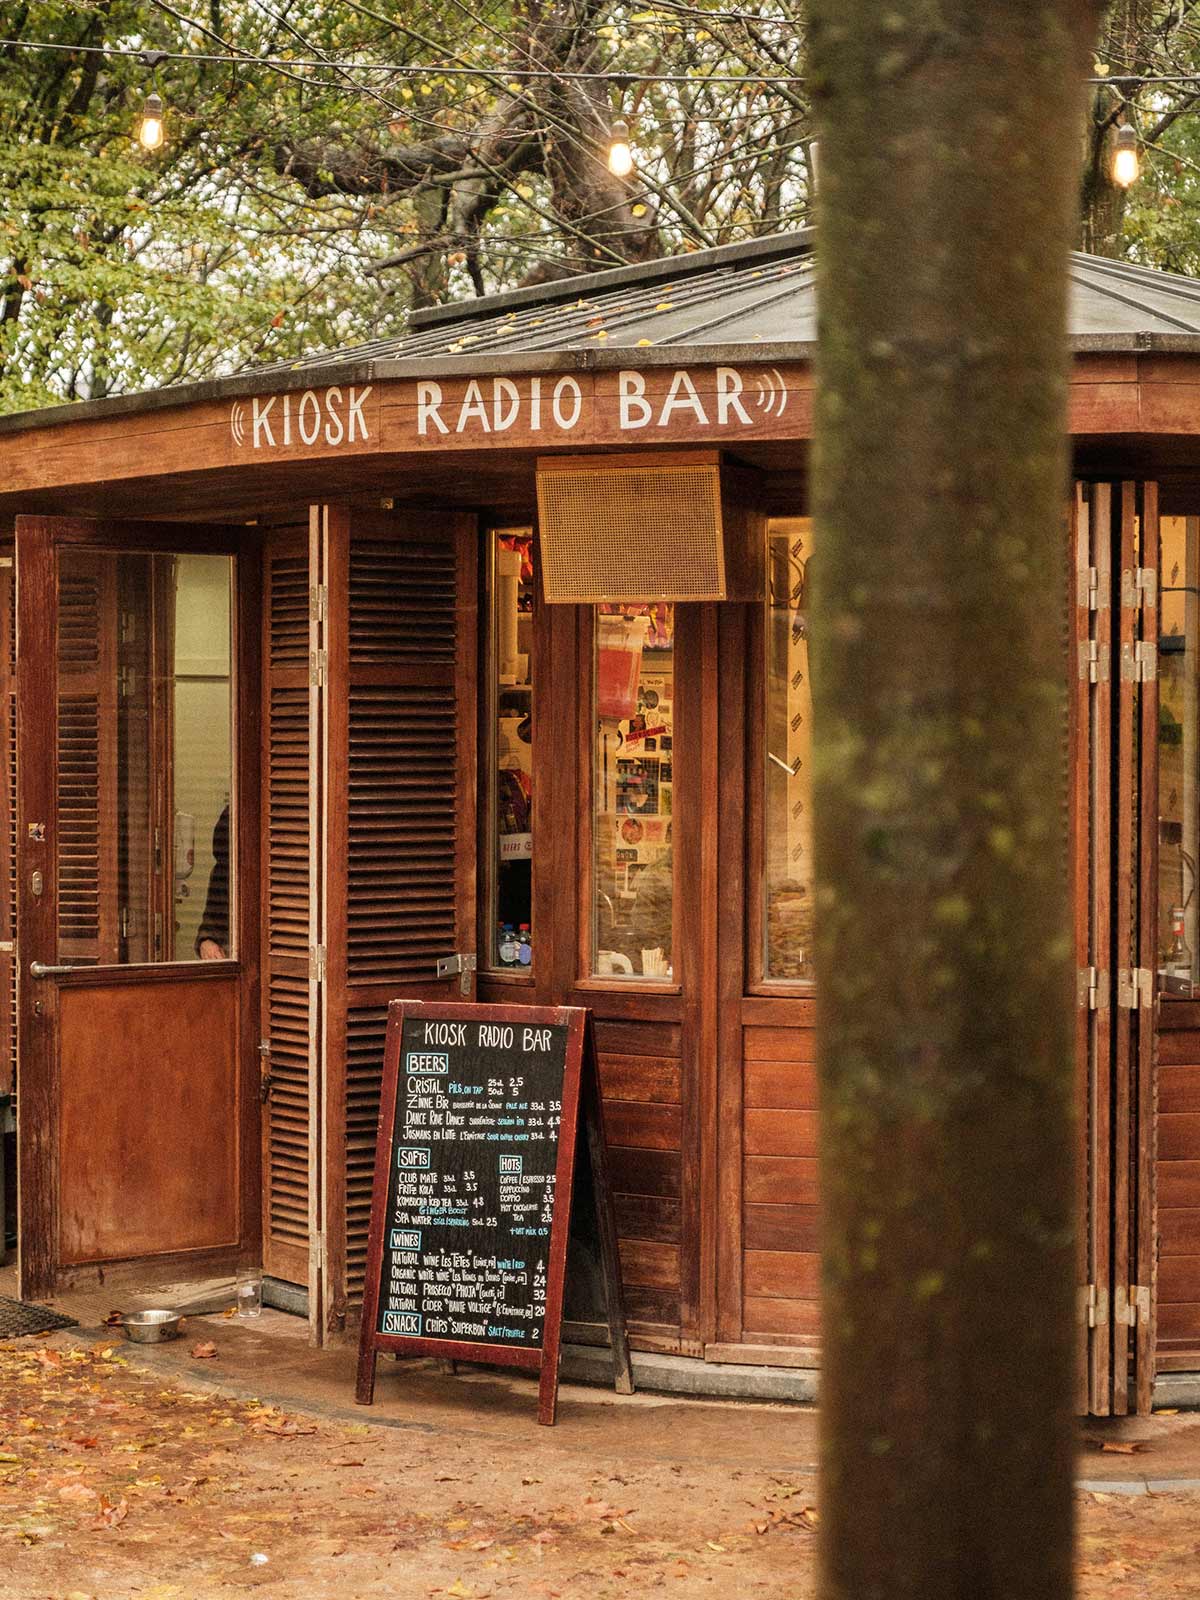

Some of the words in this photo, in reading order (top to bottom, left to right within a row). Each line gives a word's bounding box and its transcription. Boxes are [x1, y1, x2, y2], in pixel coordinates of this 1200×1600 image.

[252, 385, 374, 448] KIOSK
[416, 375, 582, 436] RADIO
[619, 367, 754, 430] BAR
[424, 1022, 467, 1047] KIOSK
[478, 1024, 514, 1049] RADIO
[522, 1028, 552, 1052] BAR
[409, 1055, 447, 1073] BEERS
[509, 1077, 524, 1087] 2.5
[512, 1087, 519, 1096] 5
[505, 1102, 518, 1110] PALE
[518, 1102, 528, 1110] ALE
[549, 1100, 562, 1111] 3.5
[405, 1110, 427, 1125] DANCE
[446, 1111, 465, 1126] DANCE
[398, 1171, 418, 1183] CLUB
[419, 1172, 438, 1184] MATE
[463, 1170, 476, 1180] 3.5
[419, 1185, 434, 1195] KOLA
[465, 1182, 478, 1192] 3.5
[545, 1185, 552, 1194] 3
[396, 1195, 427, 1207] KOMBUCHA
[440, 1198, 452, 1207] TEA
[542, 1195, 555, 1204] 3.5
[448, 1207, 467, 1215] BOOST
[500, 1204, 512, 1212] HOT
[543, 1204, 551, 1215] 4
[394, 1210, 410, 1224] SPA
[411, 1215, 432, 1226] WATER
[486, 1217, 498, 1227] 2.5
[512, 1213, 524, 1222] TEA
[391, 1250, 419, 1265] NATURAL
[536, 1259, 545, 1273] 4
[533, 1275, 546, 1287] 24
[390, 1280, 418, 1296] NATURAL
[423, 1282, 452, 1297] PROSECCO
[533, 1289, 547, 1301] 32
[389, 1296, 418, 1311] NATURAL
[534, 1306, 546, 1317] 20
[386, 1313, 418, 1332] SNACK
[531, 1328, 539, 1339] 2
